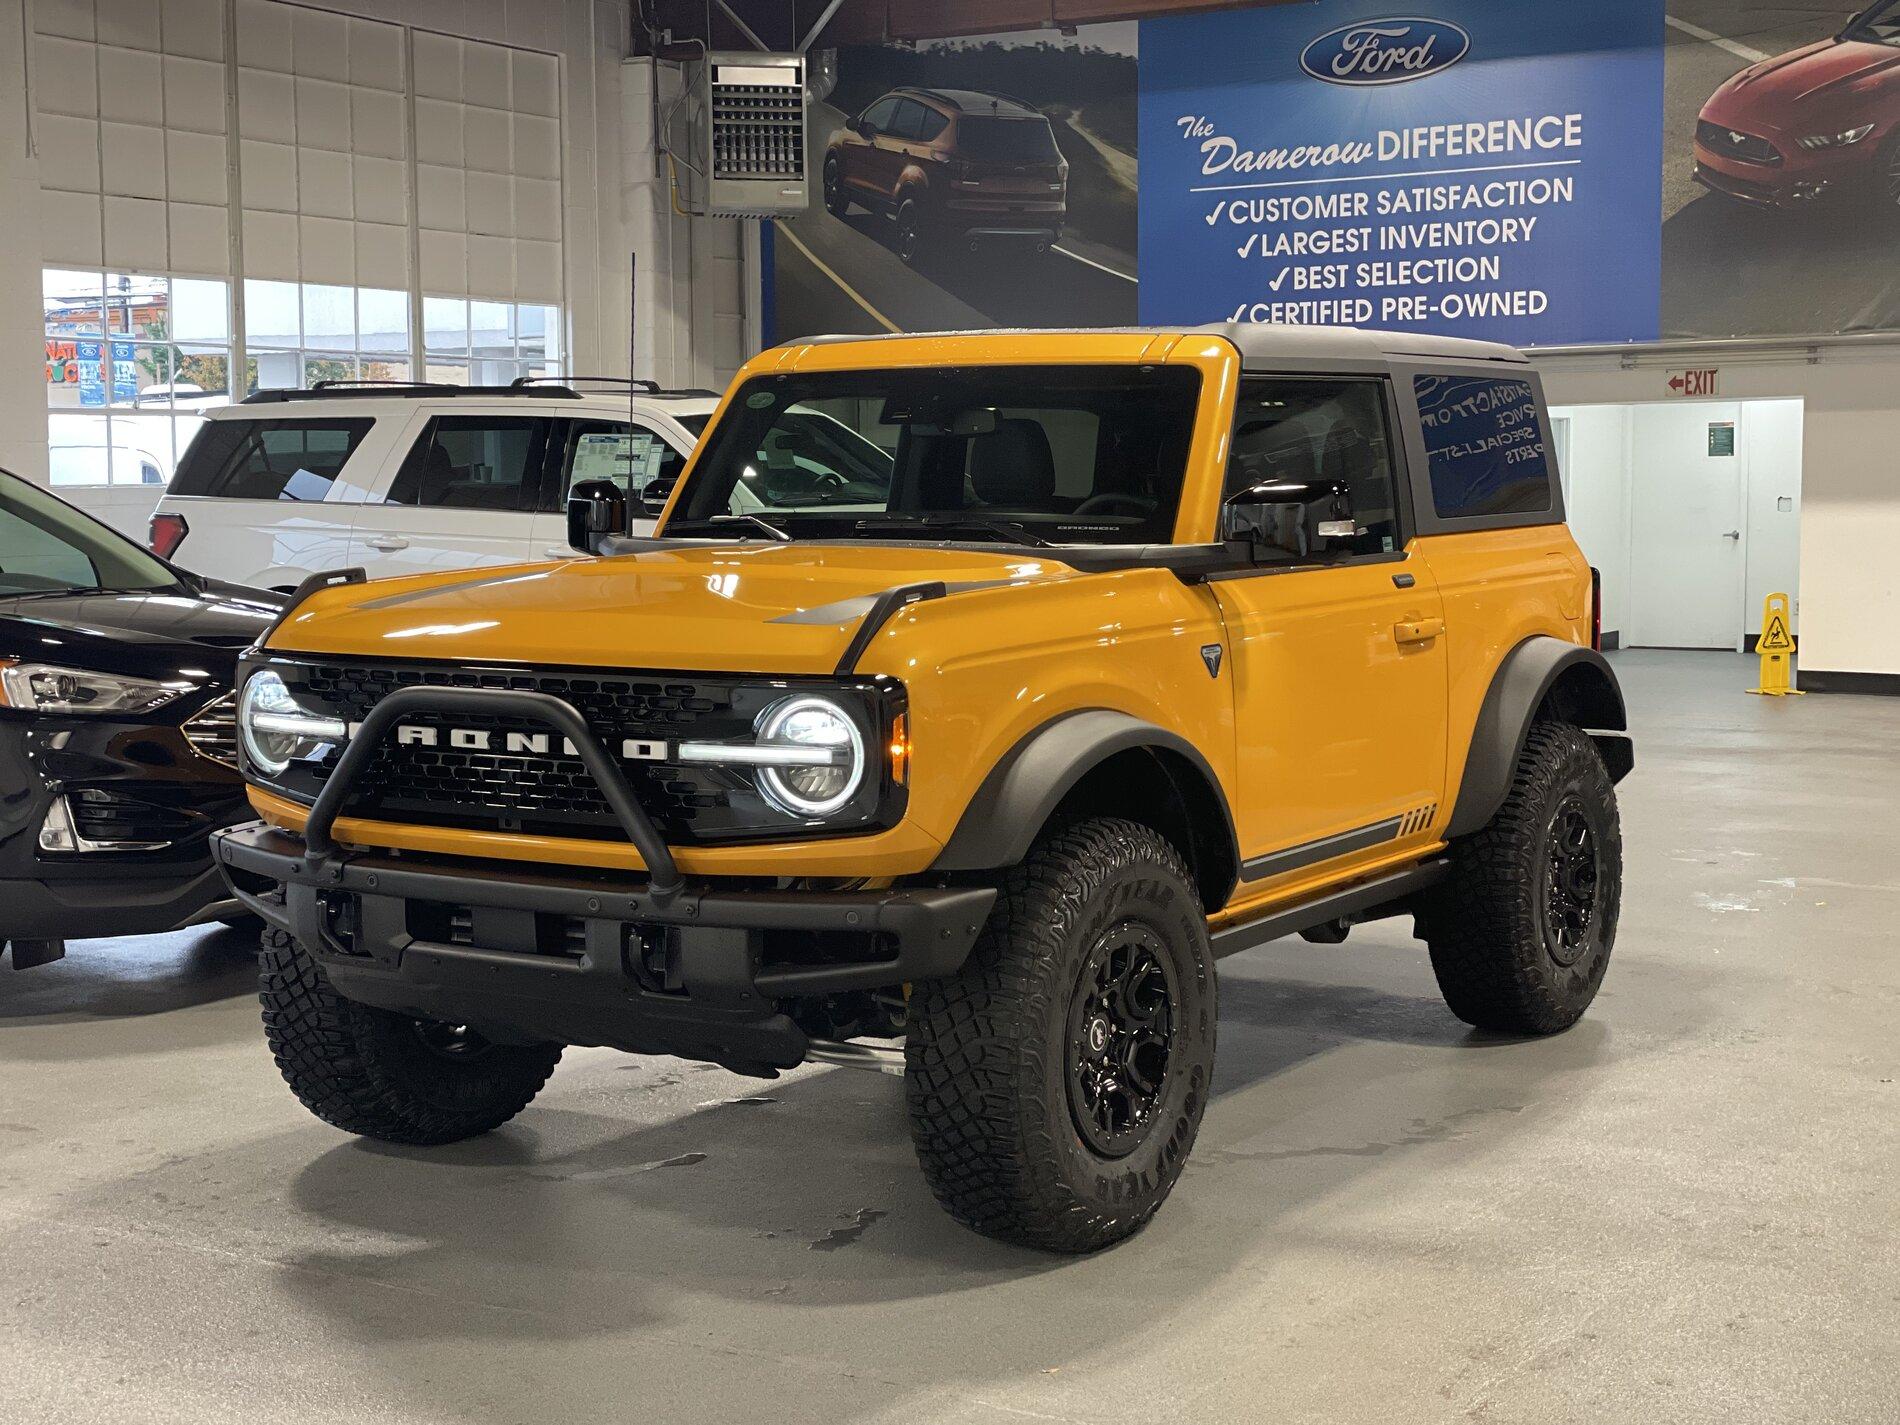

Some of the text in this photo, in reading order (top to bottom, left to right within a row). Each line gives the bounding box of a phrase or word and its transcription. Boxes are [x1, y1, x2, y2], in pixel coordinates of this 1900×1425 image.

[1331, 26, 1436, 76] Ford
[1177, 116, 1214, 139] The
[1201, 114, 1582, 175] Damerow DIFFERENCE
[1229, 178, 1573, 225] CUSTOMER SATISFACTION
[1261, 217, 1537, 258] LARGEST INVENTORY
[1294, 256, 1500, 290] BEST SELECTION
[1249, 291, 1548, 325] CERTIFIED PRE-OWNED
[1685, 369, 1717, 395] EXIT
